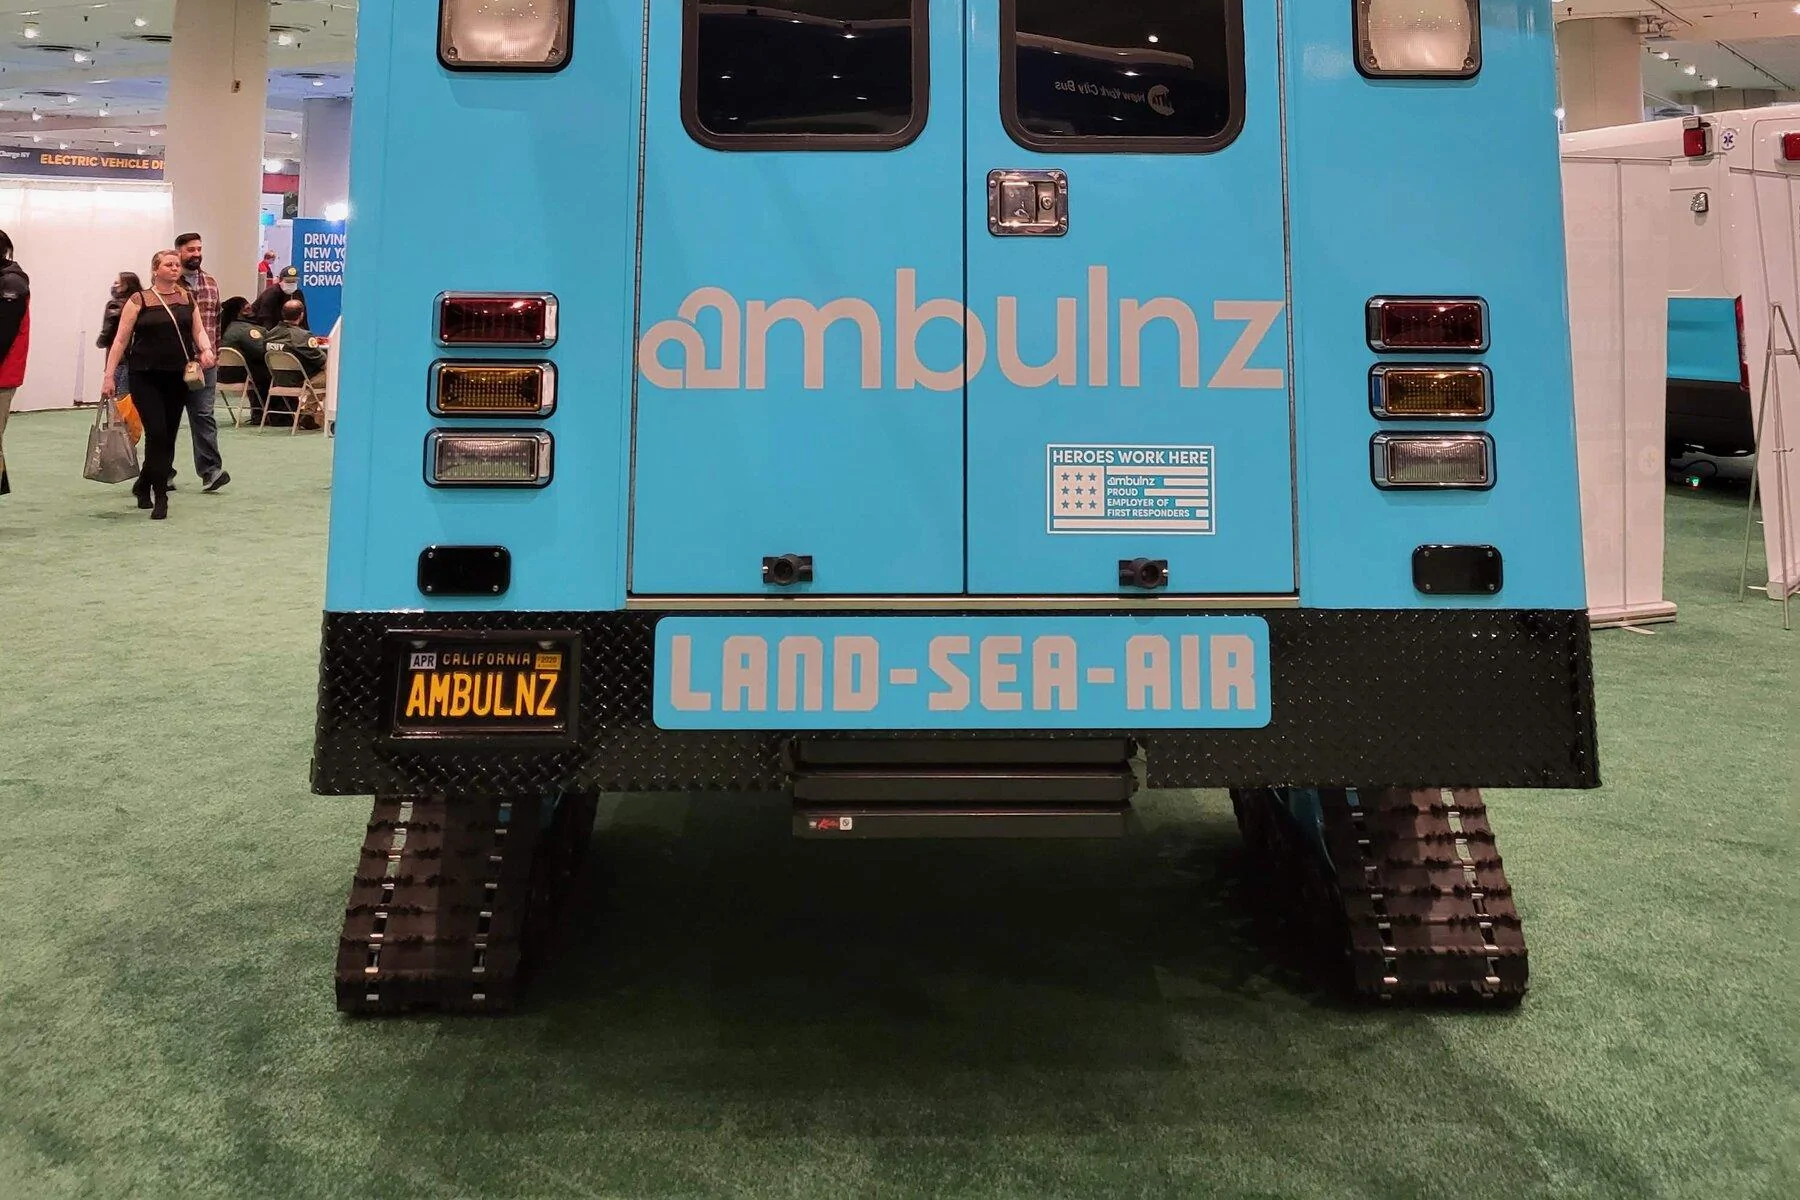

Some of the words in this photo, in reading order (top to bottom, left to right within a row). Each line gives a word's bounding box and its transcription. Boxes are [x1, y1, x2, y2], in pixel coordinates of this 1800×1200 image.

[40, 154, 100, 167] ELECTRIC
[100, 157, 149, 169] VEHICLE
[304, 247, 331, 259] NEW
[638, 265, 1286, 391] ambulnz
[1053, 450, 1114, 464] HEROES
[1118, 450, 1165, 464] WORK
[1169, 451, 1208, 464] HERE
[1107, 476, 1155, 486] ambulnz
[1107, 488, 1138, 496] PROUD
[1107, 498, 1154, 507] EMPLOYER
[1157, 498, 1169, 507] OF
[1107, 509, 1130, 517] FIRST
[1132, 509, 1190, 517] RESPONDERS
[413, 654, 434, 667] APR
[442, 653, 530, 666] CALIFORNIA
[405, 672, 558, 717] AMBULNZ
